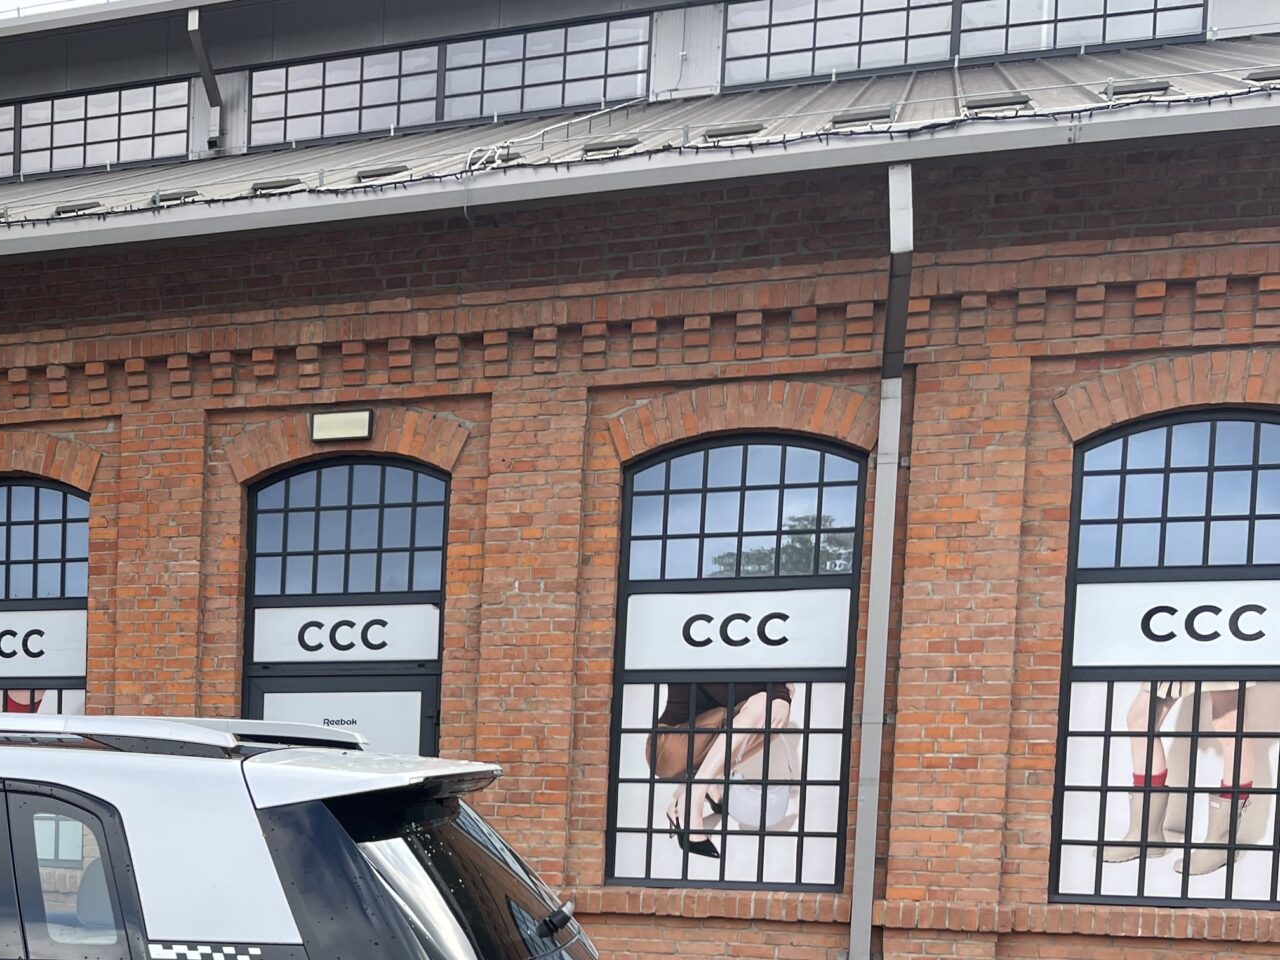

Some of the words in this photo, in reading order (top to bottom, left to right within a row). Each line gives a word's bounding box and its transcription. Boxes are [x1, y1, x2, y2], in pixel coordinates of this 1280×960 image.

[297, 618, 389, 652] CCC
[682, 612, 790, 648] CCC
[1140, 604, 1267, 643] CCC
[323, 718, 357, 727] Reebok
